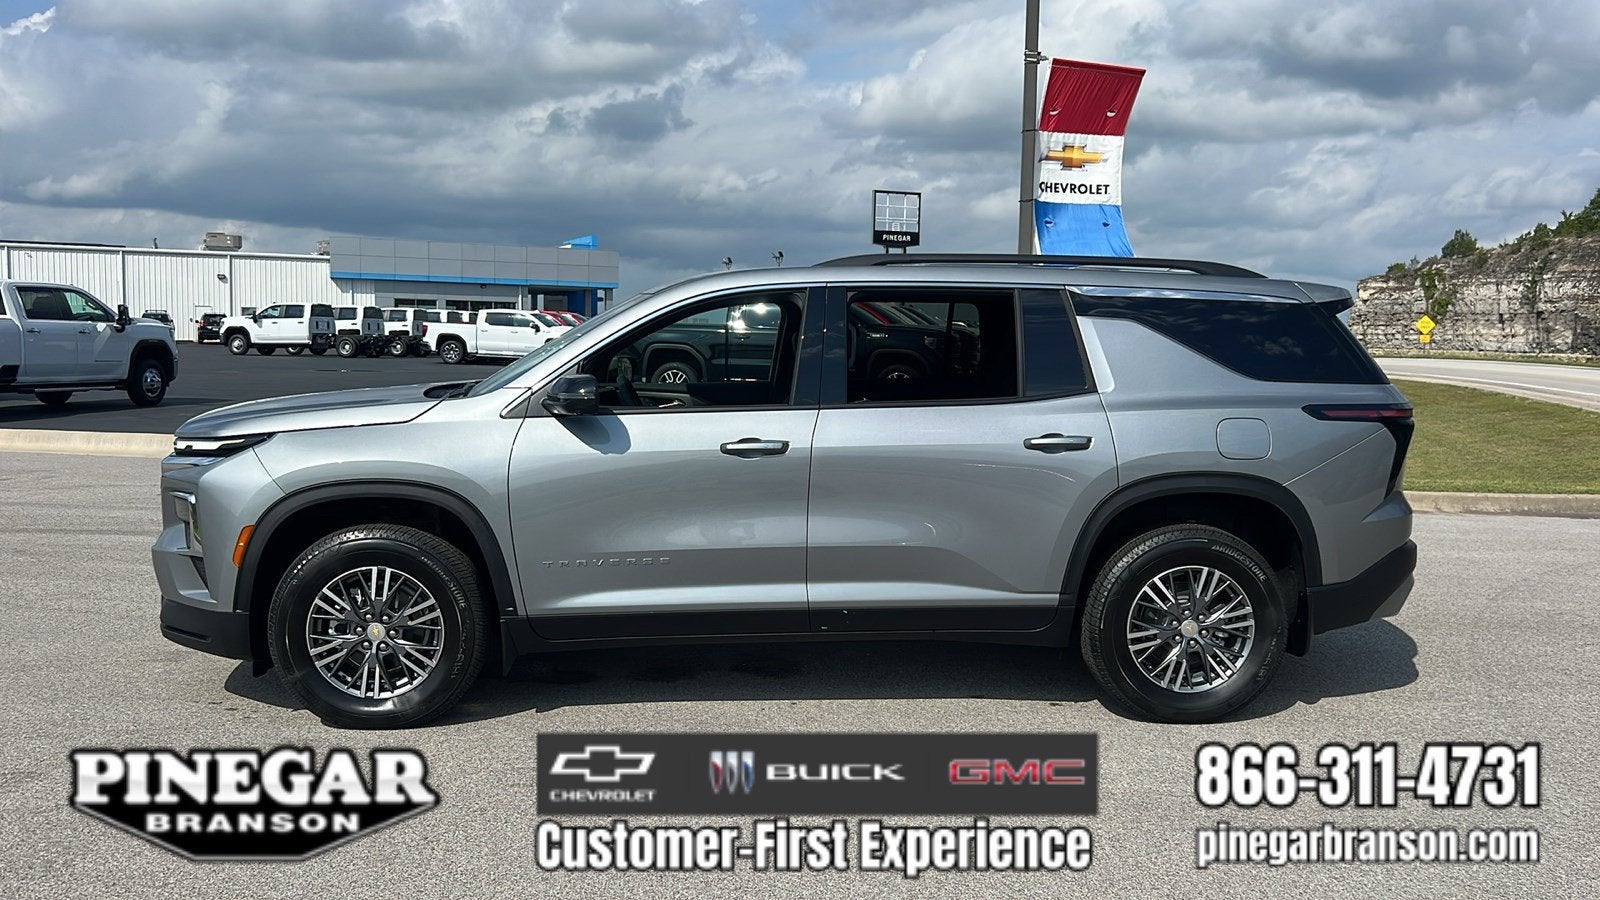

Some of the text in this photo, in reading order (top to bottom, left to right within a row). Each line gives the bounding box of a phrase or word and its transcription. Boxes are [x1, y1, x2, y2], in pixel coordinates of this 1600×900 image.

[1039, 181, 1110, 195] CHEVROLET
[882, 233, 911, 242] PINEGAR
[542, 557, 672, 569] TRAVERSE
[1211, 544, 1268, 583] BRIDGESTONE
